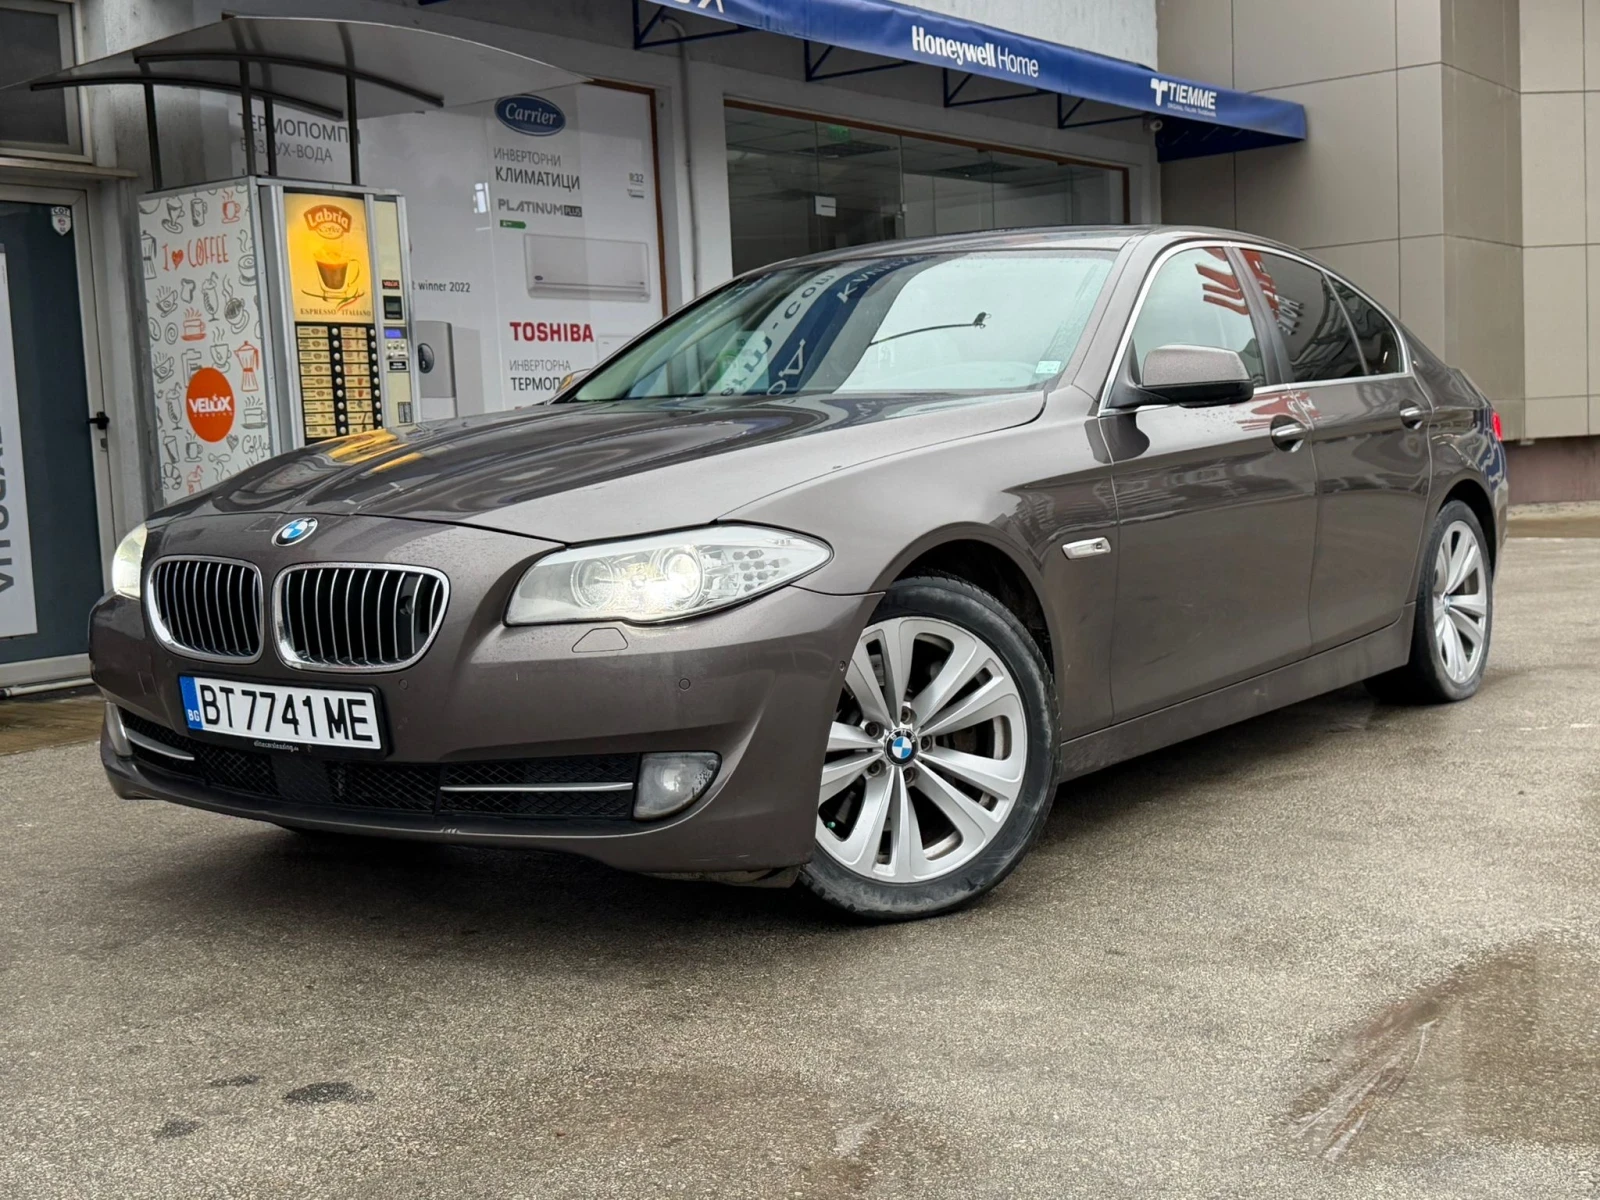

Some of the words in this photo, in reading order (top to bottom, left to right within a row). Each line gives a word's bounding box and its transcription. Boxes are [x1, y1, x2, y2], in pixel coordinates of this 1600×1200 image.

[911, 25, 996, 68] Honeywell
[998, 45, 1039, 78] Home
[1168, 82, 1217, 110] TIEMME
[505, 102, 557, 125] Carrier
[494, 148, 562, 167] ИНВЕРТОРНИ
[495, 166, 580, 192] КЛИМАТИЦИ
[498, 198, 564, 216] PLATINUM
[307, 207, 349, 229] Labria
[187, 233, 230, 268] COFFEE
[418, 280, 447, 292] winner
[449, 281, 471, 293] 2022
[300, 307, 337, 316] ESPRESSO
[341, 307, 372, 317] ITALIANO
[509, 321, 595, 342] TOSHIBA
[509, 359, 572, 371] ИНВЕРТОРНА
[188, 394, 232, 413] VELUX
[187, 709, 200, 722] BG
